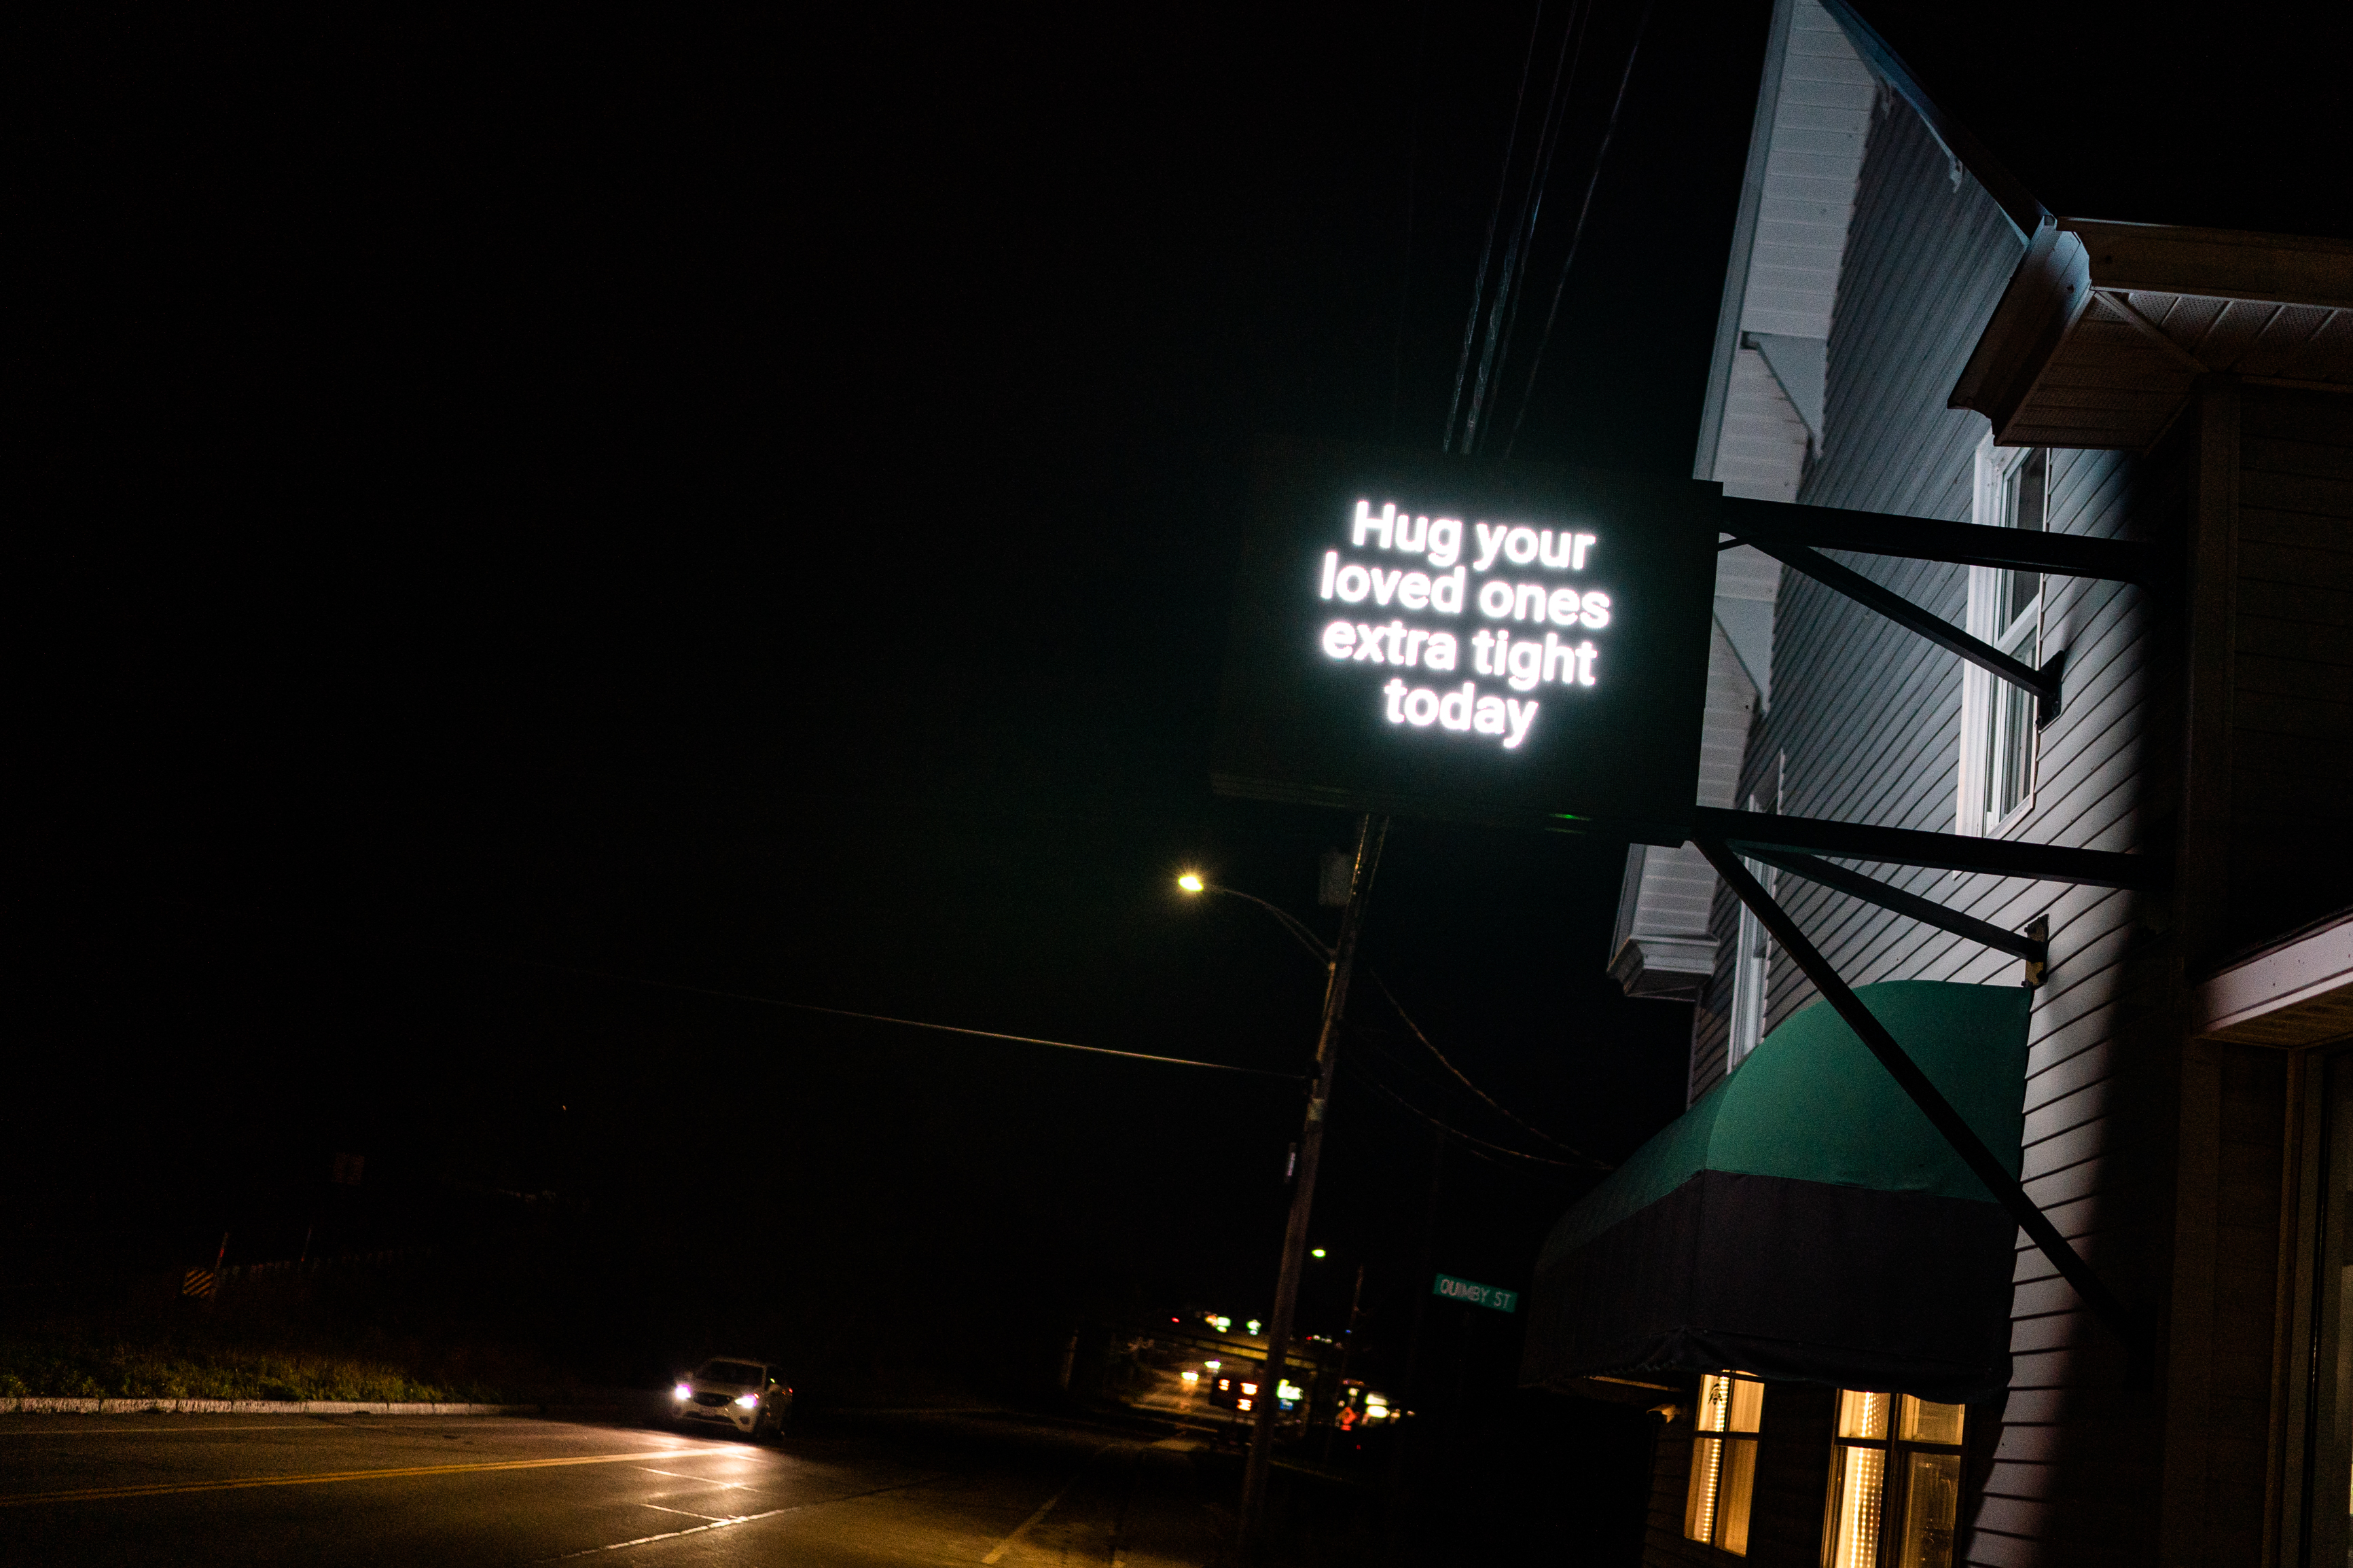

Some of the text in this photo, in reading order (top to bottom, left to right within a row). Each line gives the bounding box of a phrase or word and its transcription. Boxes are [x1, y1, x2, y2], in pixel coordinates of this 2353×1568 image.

[1354, 500, 1596, 571] Hug your
[1321, 551, 1611, 629] loved ones
[1323, 620, 1598, 691] extra tight
[1384, 679, 1539, 748] today
[1440, 1279, 1511, 1308] QUIMBY ST
